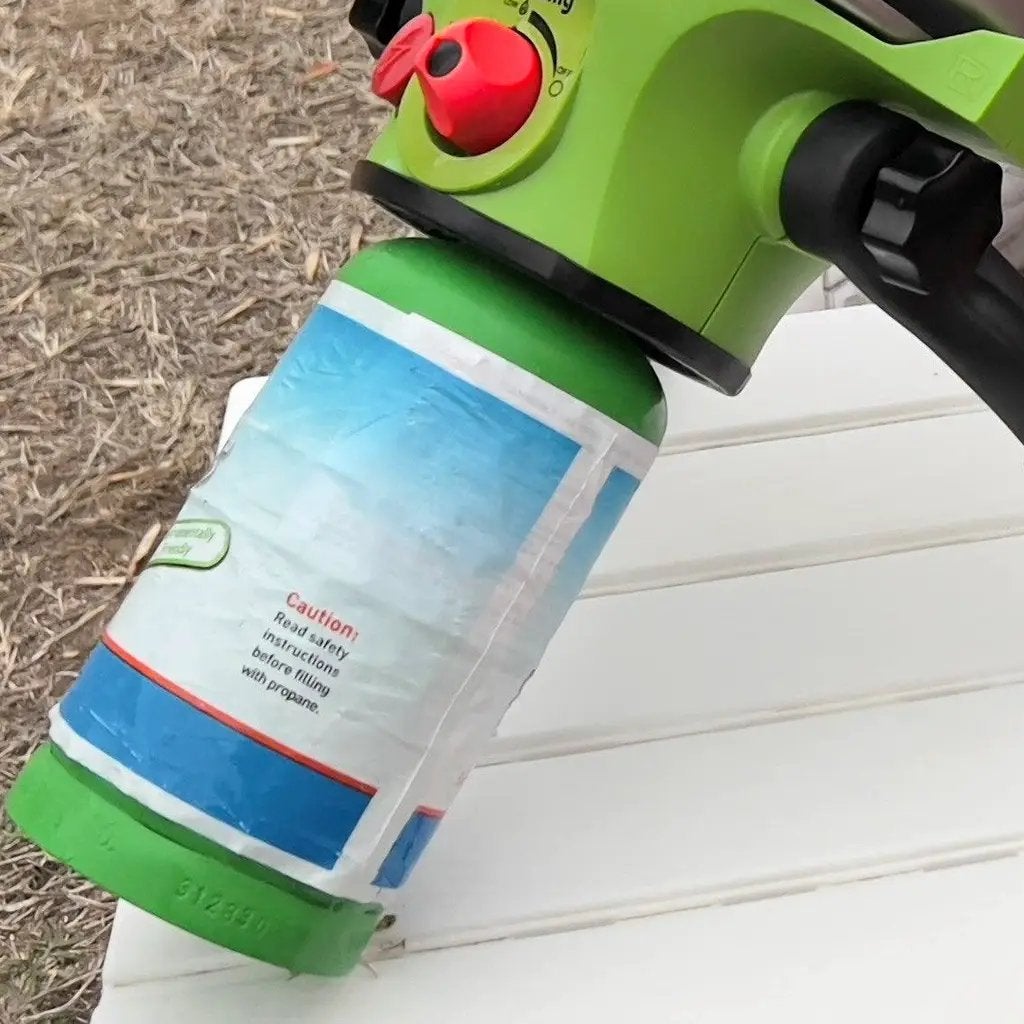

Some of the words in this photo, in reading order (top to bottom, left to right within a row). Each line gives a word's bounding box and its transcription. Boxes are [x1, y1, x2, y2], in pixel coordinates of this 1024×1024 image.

[262, 628, 340, 678] instructions
[273, 611, 309, 637] Read
[309, 632, 350, 662] safety
[241, 664, 267, 685] with
[266, 679, 320, 714] propane.
[251, 645, 293, 675] before
[294, 668, 331, 698] filling
